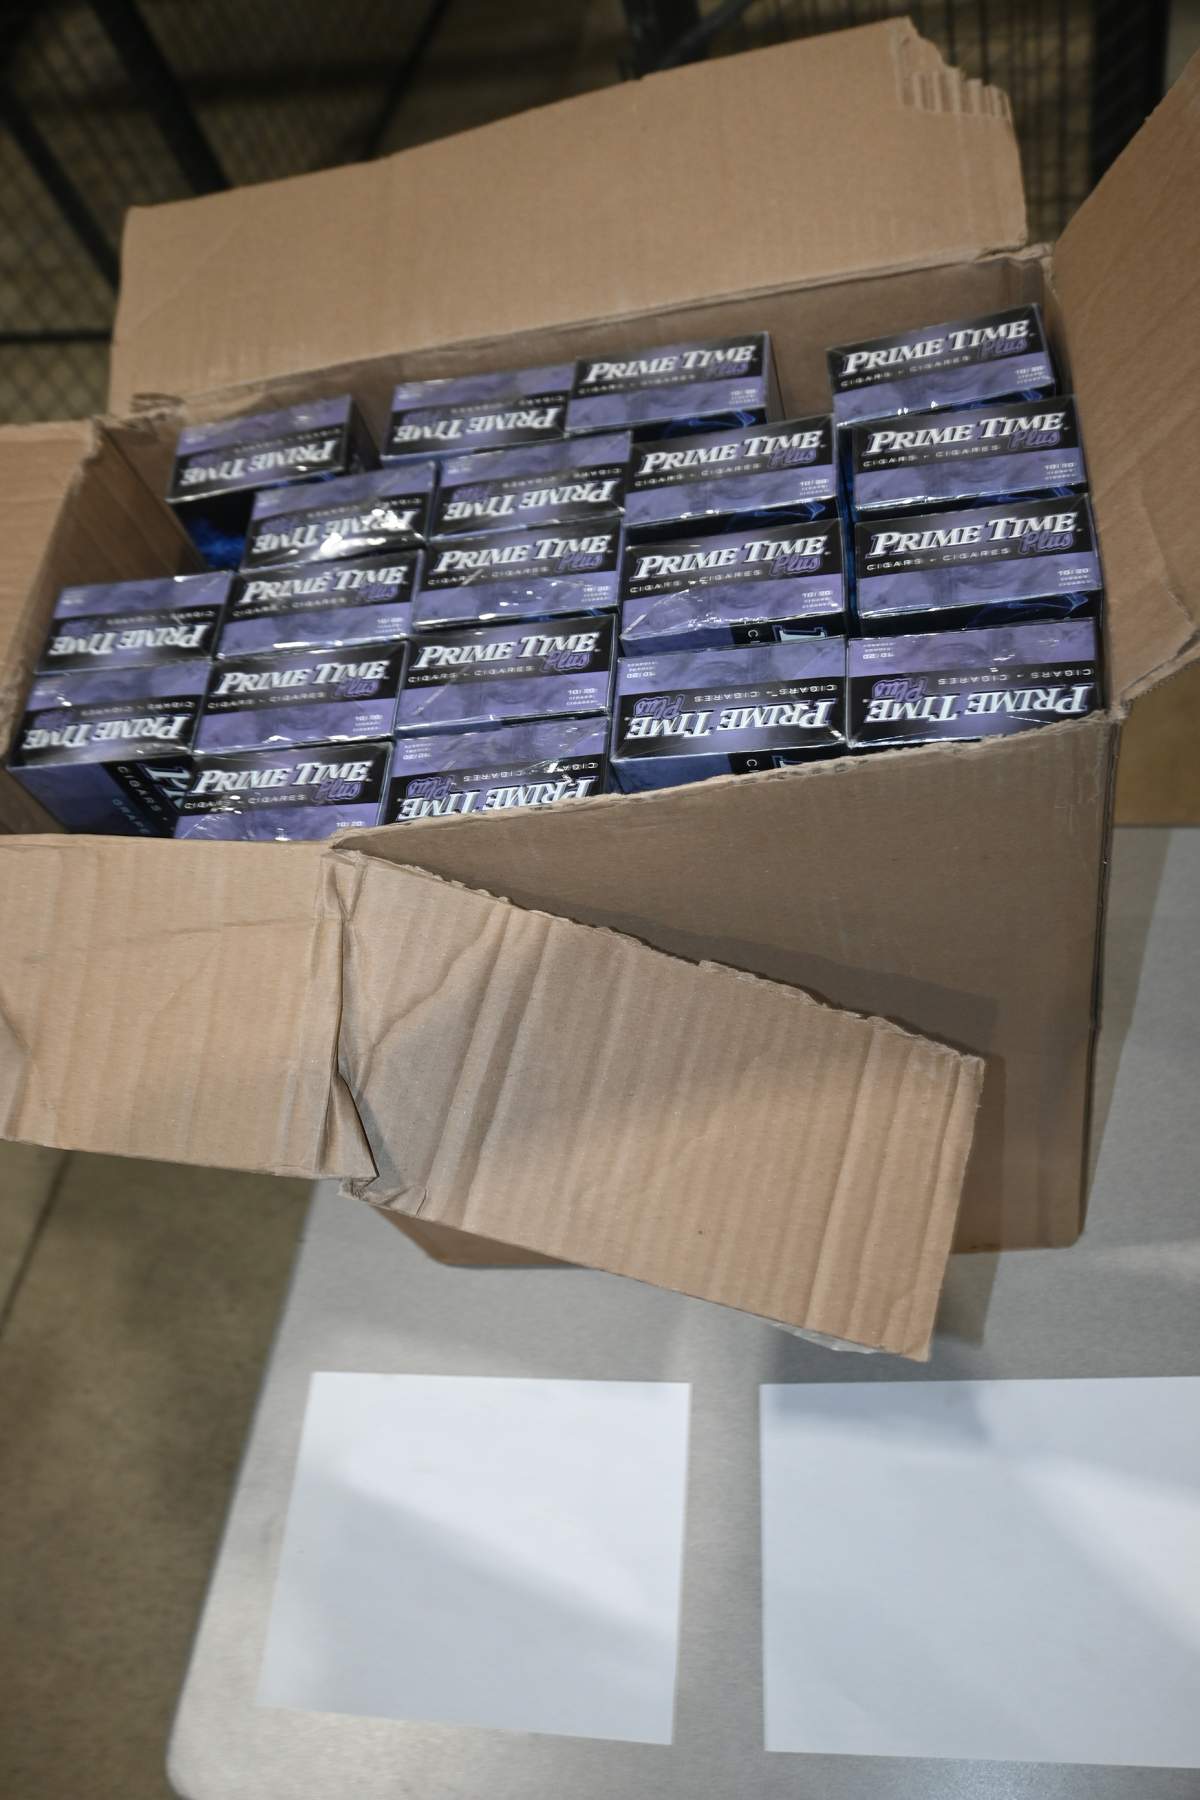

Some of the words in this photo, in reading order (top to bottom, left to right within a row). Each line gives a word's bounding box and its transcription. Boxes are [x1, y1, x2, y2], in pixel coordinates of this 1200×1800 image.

[841, 339, 943, 376] PRIME
[945, 319, 1030, 350] TIME
[581, 356, 678, 384] PRIME
[681, 345, 756, 368] TIME
[841, 372, 892, 387] CIGARS
[909, 355, 971, 373] CIGARES
[394, 419, 464, 442] TIME
[467, 408, 561, 433] PRIME
[862, 424, 975, 456] PRIME
[979, 412, 1066, 438] TIME
[1007, 430, 1062, 450] Plus
[248, 440, 336, 472] PRIME
[635, 443, 739, 476] PRIME
[741, 430, 823, 457] TIME
[768, 449, 817, 467] Plus
[863, 455, 917, 468] CIGARS
[935, 445, 1000, 459] CIGARES
[635, 475, 682, 487] CIGARS
[701, 464, 760, 477] CIGARES
[443, 494, 515, 520] TIME
[519, 481, 618, 509] PRIME
[252, 525, 321, 553] TIME
[865, 524, 984, 559] PRIME
[985, 512, 1077, 541] TIME
[1020, 532, 1074, 552] Plus
[430, 545, 531, 574] PRIME
[533, 535, 612, 559] TIME
[553, 552, 603, 572] Plus
[630, 548, 739, 581] PRIME
[741, 535, 829, 563] TIME
[769, 555, 822, 576] Plus
[867, 558, 921, 571] CIGARS
[943, 548, 1009, 561] CIGARES
[492, 566, 549, 578] CIGARES
[630, 580, 681, 593] CIGARS
[700, 569, 762, 584] CIGARES
[239, 574, 331, 604] PRIME
[333, 566, 408, 591] TIME
[48, 632, 115, 656] TIME
[117, 625, 211, 649] PRIME
[409, 642, 516, 671] PRIME
[517, 632, 599, 658] TIME
[540, 651, 593, 673] Plus
[210, 669, 311, 697] PRIME
[313, 660, 390, 685] TIME
[408, 672, 457, 683] CIGARS
[474, 665, 535, 676] CIGARES
[938, 674, 1008, 686] CIGARES
[1031, 668, 1092, 680] CIGARS
[269, 692, 326, 703] CIGARES
[694, 691, 761, 702] CIGARES
[779, 684, 838, 696] CIGARS
[872, 677, 928, 702] Plus
[964, 683, 1095, 715] PRIME
[634, 694, 685, 720] Plus
[717, 698, 836, 730] PRIME
[864, 694, 961, 723] TIME
[22, 723, 92, 749] TIME
[92, 714, 192, 740] PRIME
[624, 711, 713, 739] TIME
[118, 766, 162, 811] CIGARS
[185, 768, 293, 796] PRIME
[293, 760, 373, 786] TIME
[407, 776, 456, 799] Plus
[463, 770, 524, 782] CIGARES
[248, 793, 304, 804] CIGARES
[316, 780, 364, 800] Plus
[483, 776, 598, 810] PRIME
